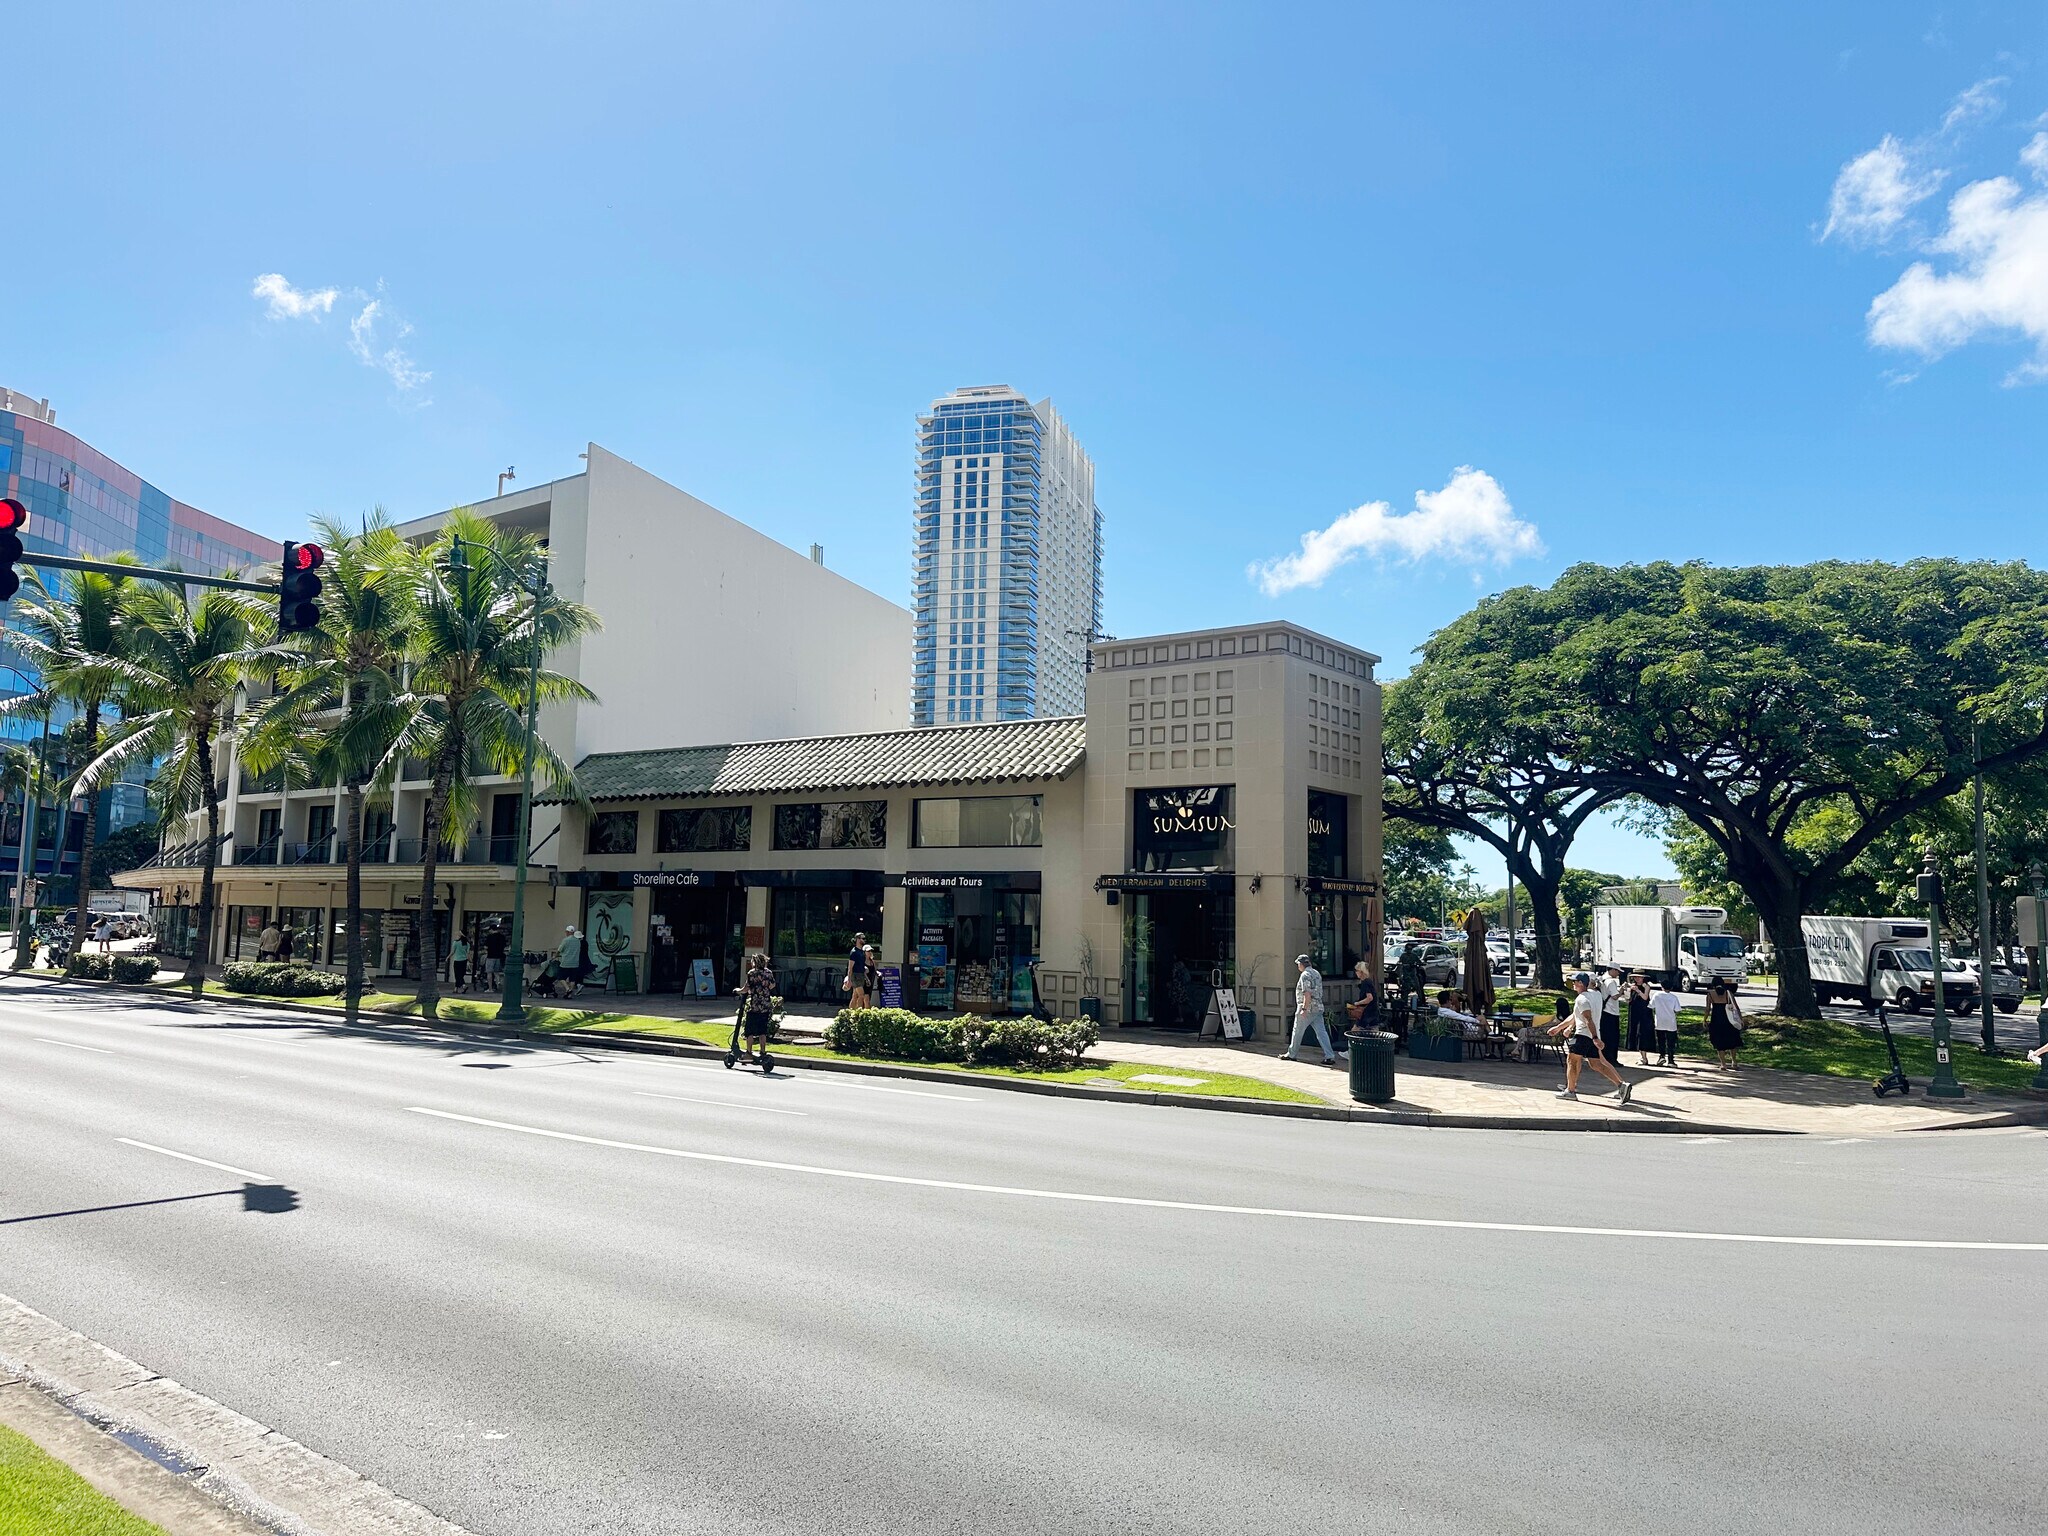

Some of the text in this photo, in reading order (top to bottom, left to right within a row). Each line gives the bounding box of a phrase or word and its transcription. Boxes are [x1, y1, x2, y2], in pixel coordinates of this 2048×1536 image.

[633, 872, 699, 885] Shoreline Cafe
[901, 876, 983, 886] Activities and Tours
[1169, 879, 1207, 887] DELIGHTS
[923, 927, 943, 935] ACTIVITY
[1808, 934, 1850, 951] TROPIC FISH
